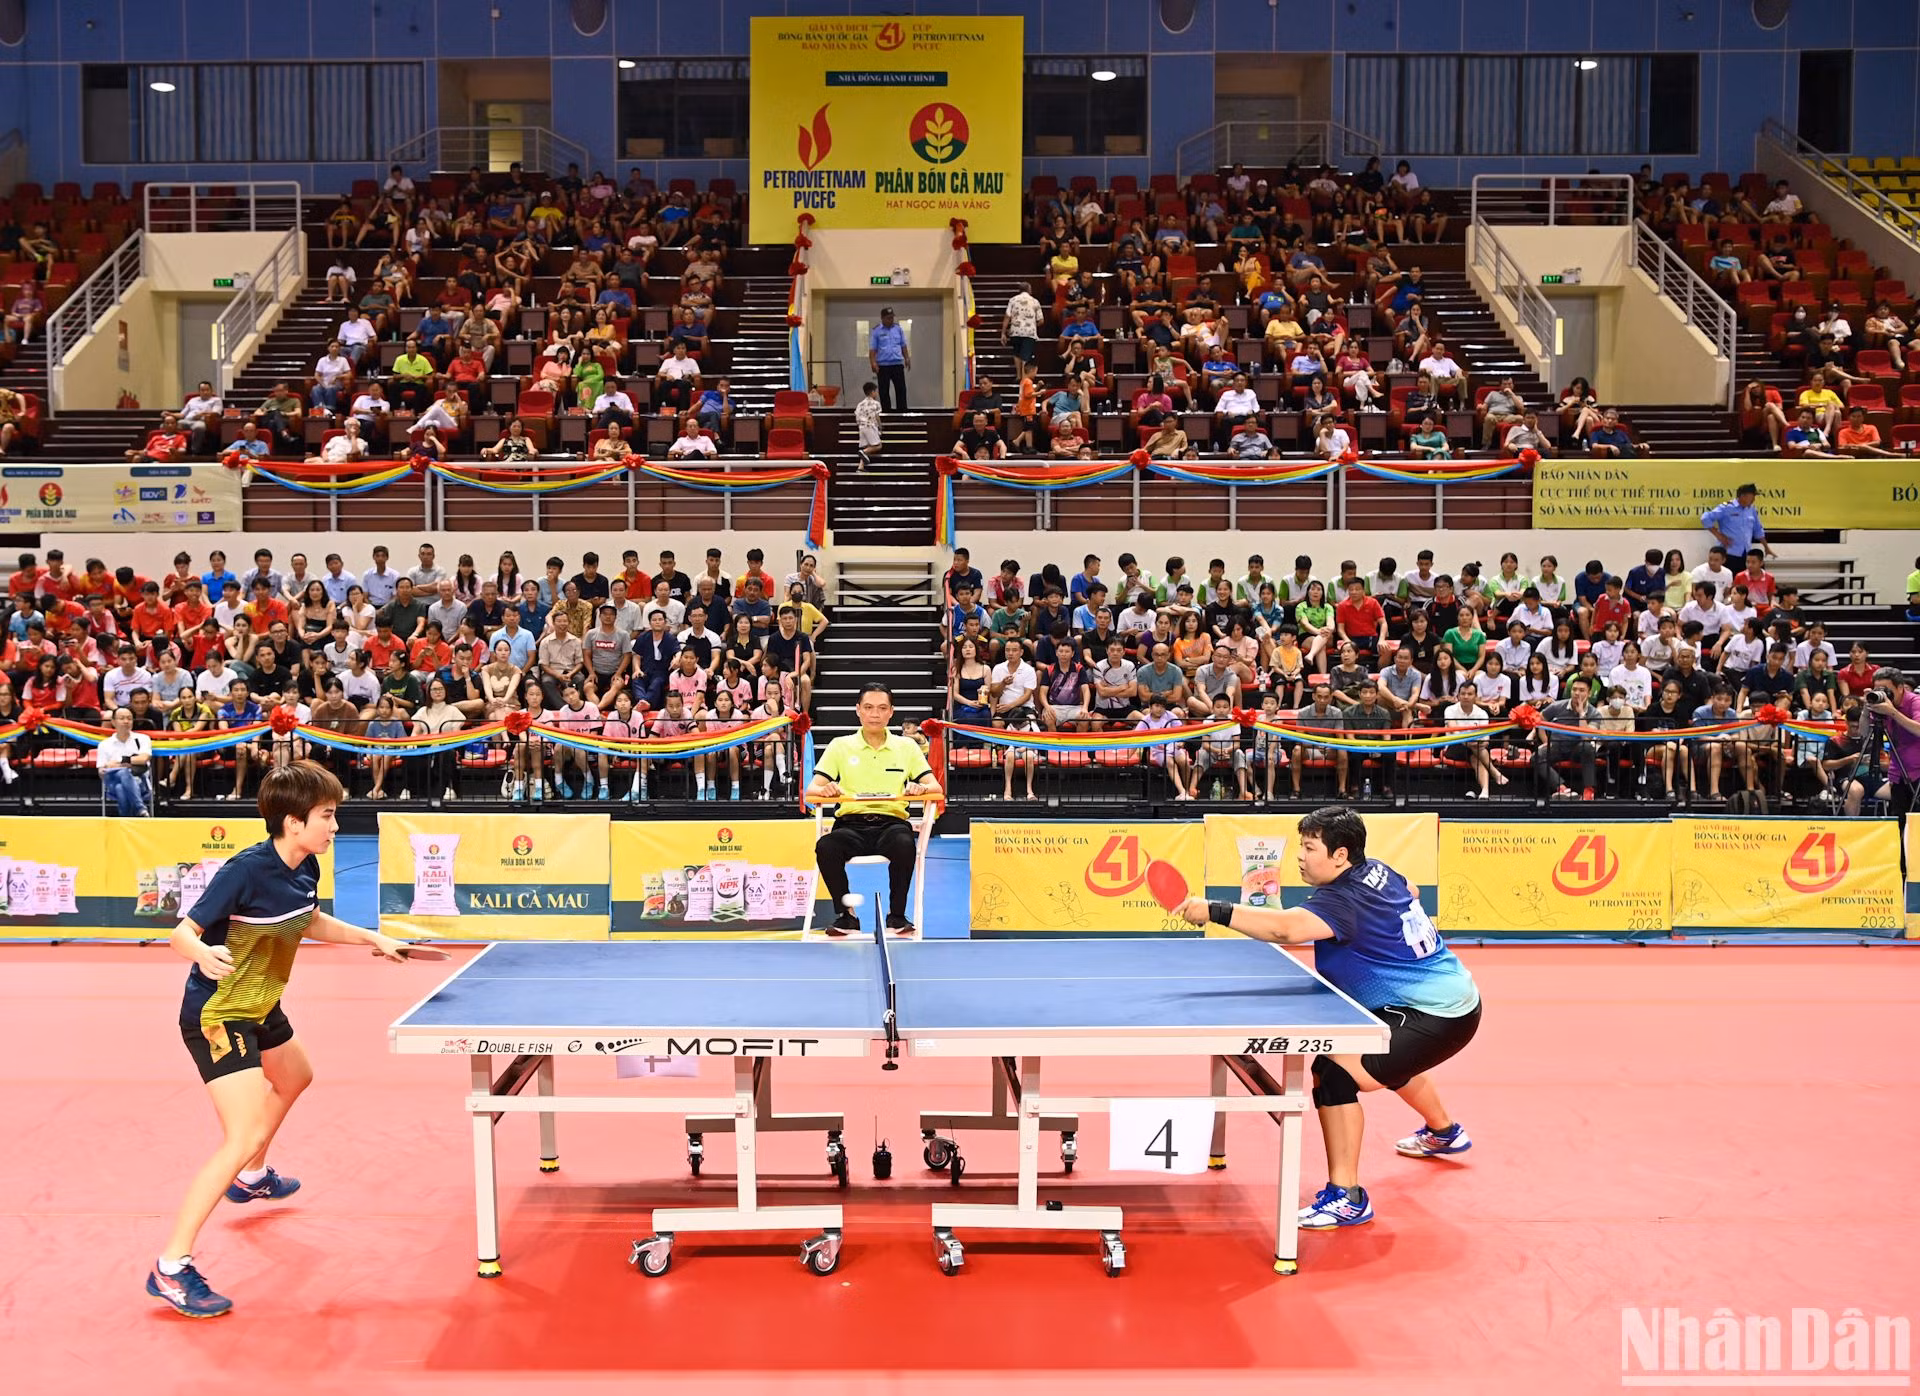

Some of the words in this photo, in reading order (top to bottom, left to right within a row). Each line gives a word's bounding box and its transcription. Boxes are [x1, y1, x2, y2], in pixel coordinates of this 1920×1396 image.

[852, 33, 868, 41] GIA
[879, 22, 900, 44] 41
[913, 33, 985, 41] PETROVIETNAM
[763, 170, 866, 188] PETROVIETNAM
[875, 167, 914, 193] PHÂN
[917, 167, 946, 194] BÓN
[950, 167, 969, 194] CÀ
[973, 172, 1004, 194] MAU
[793, 191, 836, 208] PVCFC
[906, 200, 936, 210] NGỌC
[1568, 469, 1601, 480] NHÂN
[1605, 469, 1629, 480] DÂN
[1648, 488, 1681, 498] THAO
[1658, 506, 1691, 516] THAO
[1772, 506, 1802, 516] NINH
[1073, 837, 1089, 845] GIA
[1541, 837, 1557, 845] GIA
[1771, 833, 1787, 841] GIA
[1093, 836, 1138, 881] 41
[1561, 835, 1606, 881] 41
[1791, 832, 1836, 878] 41
[422, 870, 447, 878] KALI
[719, 881, 739, 890] NPK
[748, 886, 762, 894] SA
[469, 893, 512, 908] KALI
[517, 889, 542, 908] CÀ
[547, 893, 590, 908] MAU
[1589, 899, 1661, 907] PETROVIETNAM
[1821, 897, 1894, 905] PETROVIETNAM
[1627, 917, 1663, 930] 2023
[1860, 915, 1896, 928] 2023
[477, 1040, 525, 1053] DOUBLE
[528, 1043, 553, 1053] FISH
[667, 1038, 819, 1056] MOFIT
[1243, 1036, 1290, 1054] 双鱼
[1298, 1039, 1334, 1053] 235
[1144, 1118, 1179, 1169] 4
